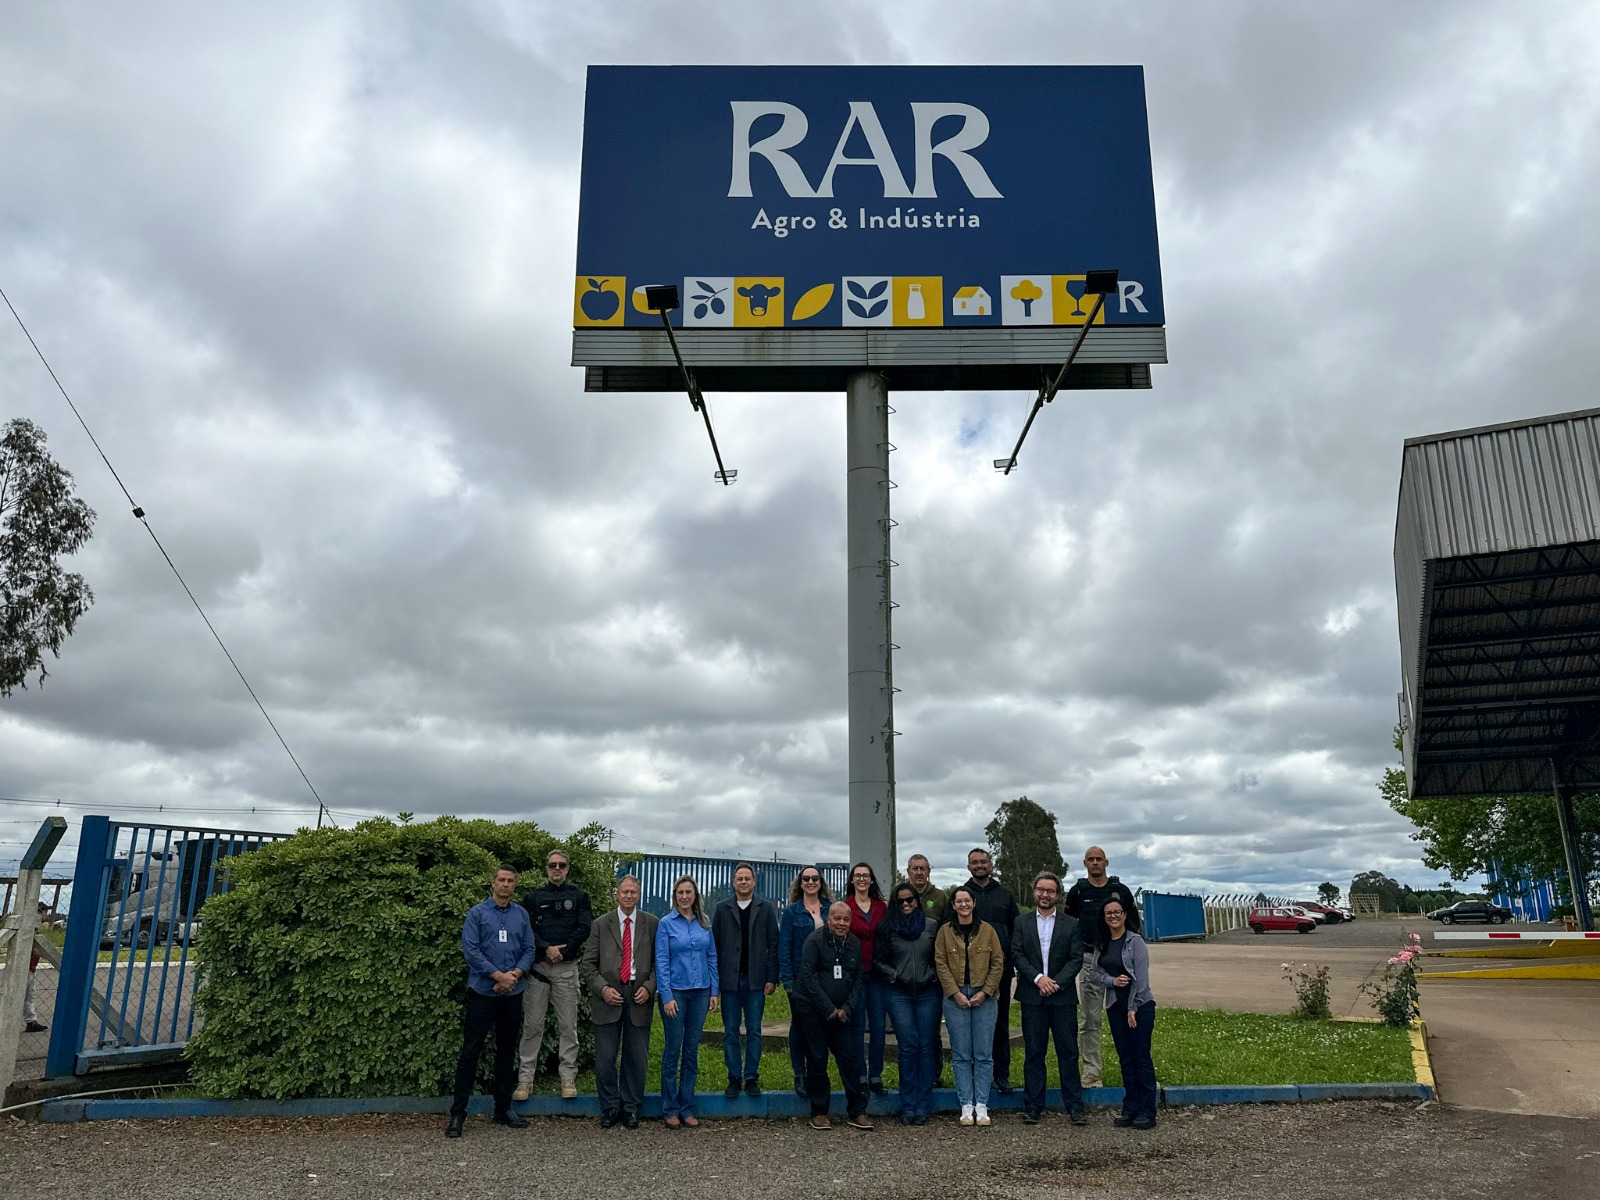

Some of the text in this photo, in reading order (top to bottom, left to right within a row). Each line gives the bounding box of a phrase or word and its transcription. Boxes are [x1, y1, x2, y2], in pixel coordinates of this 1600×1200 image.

[727, 100, 1005, 199] RAR
[751, 207, 980, 238] Agro & Indústria
